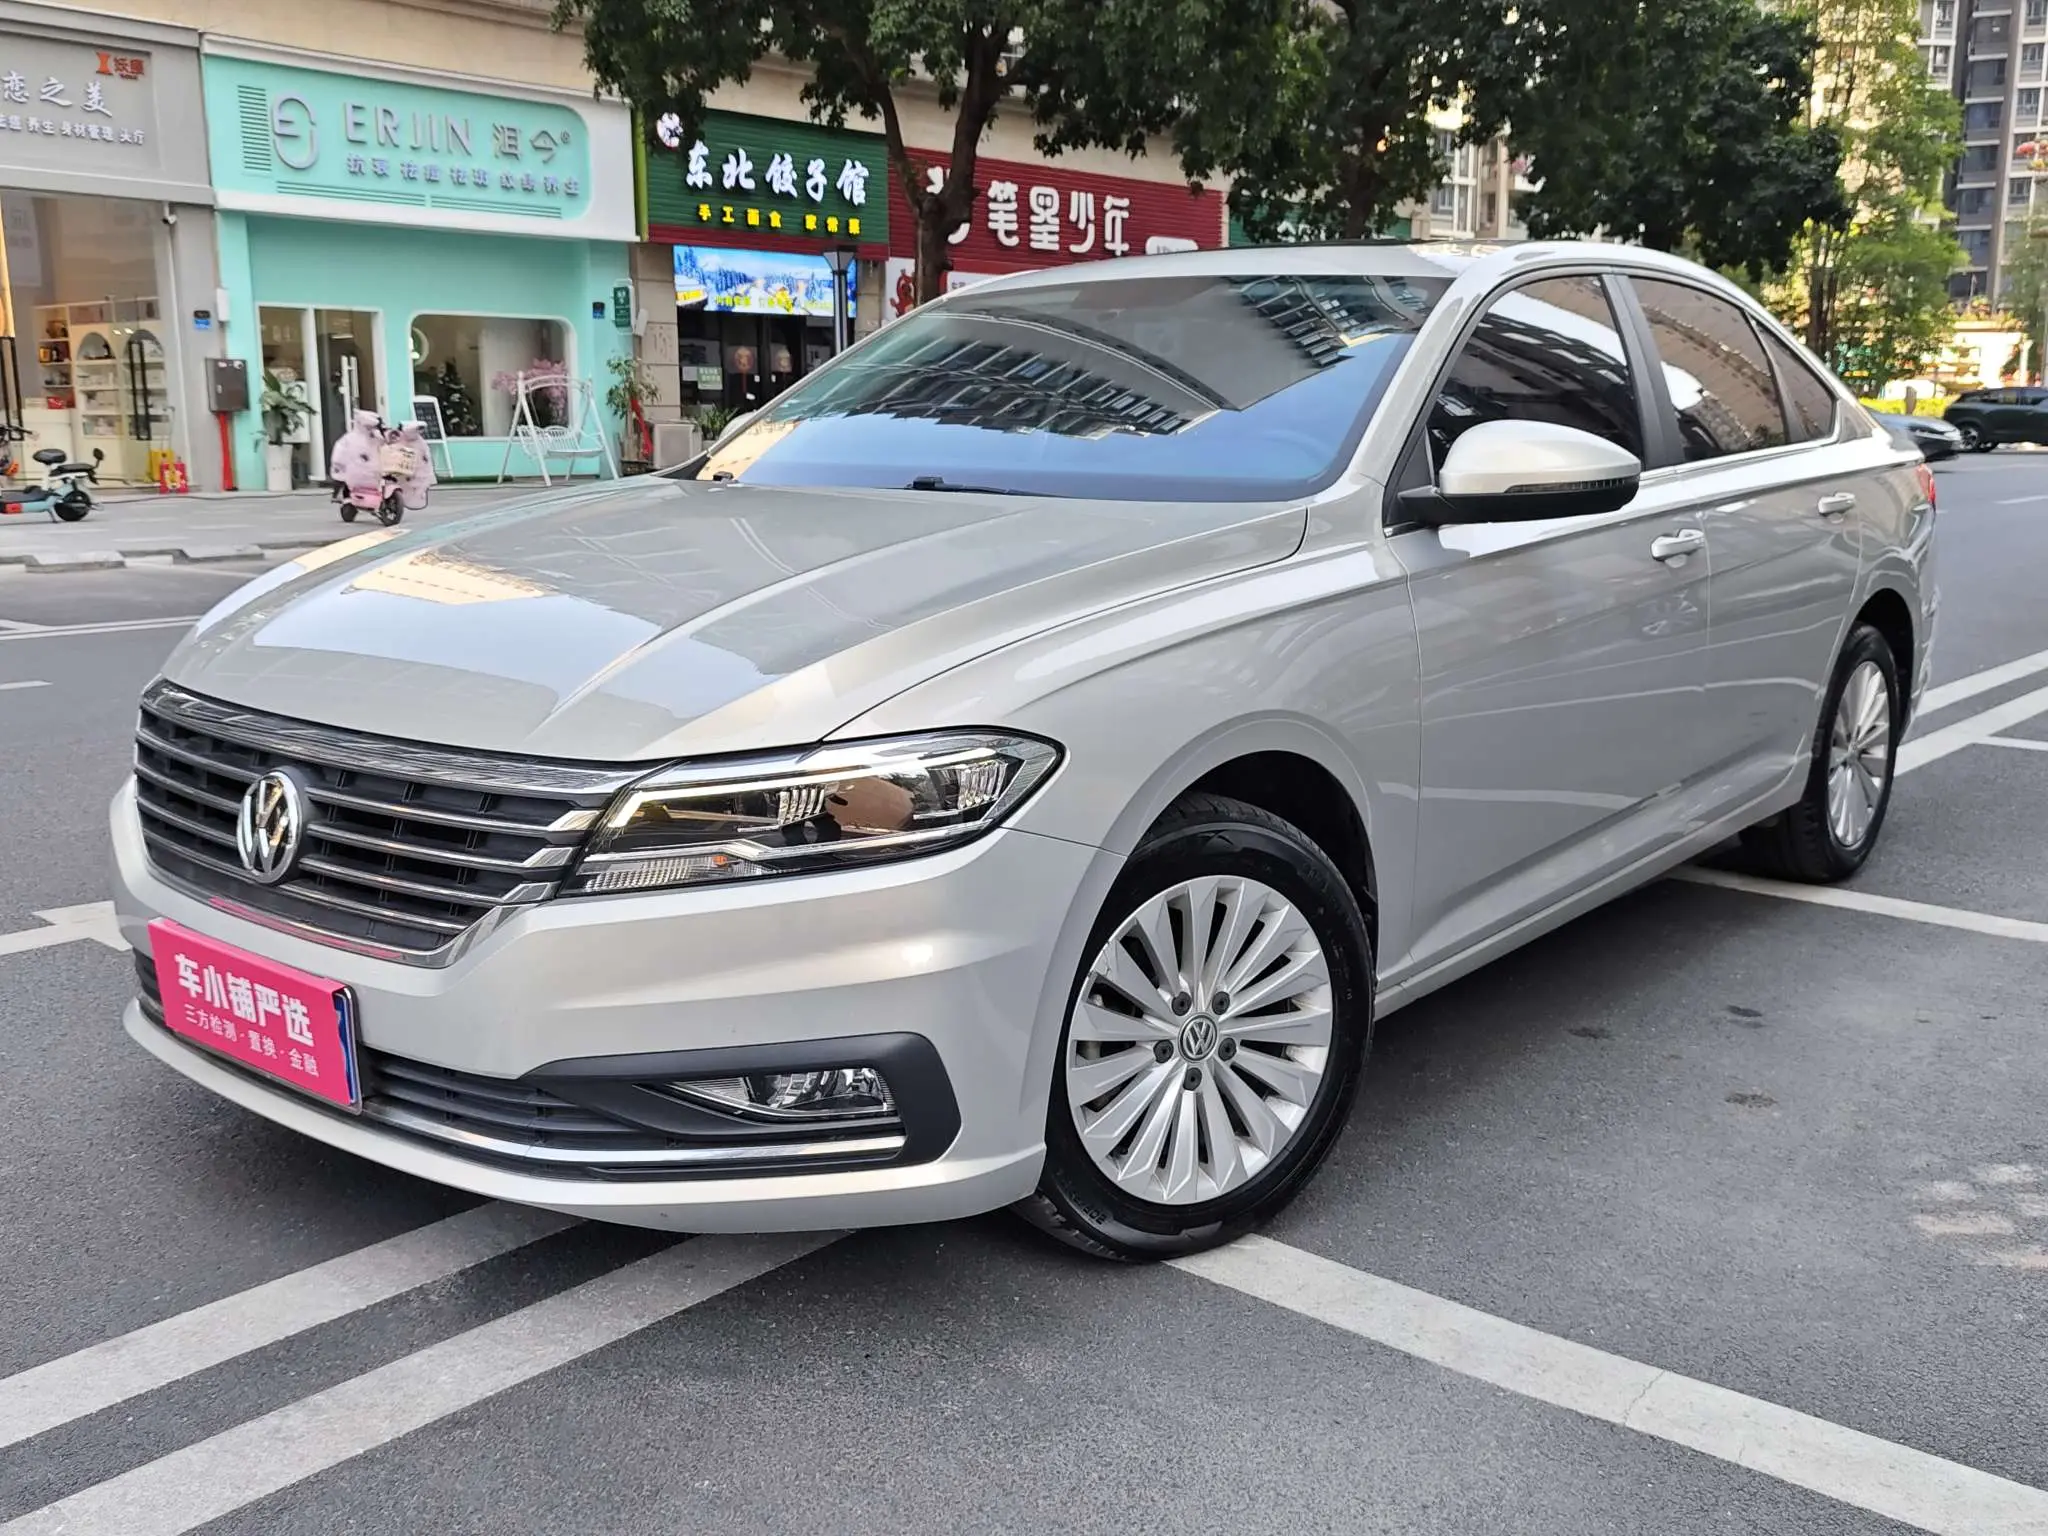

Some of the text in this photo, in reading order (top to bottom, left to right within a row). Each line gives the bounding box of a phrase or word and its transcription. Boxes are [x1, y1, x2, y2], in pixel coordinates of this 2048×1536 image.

[344, 101, 473, 157] ERJIN
[686, 139, 869, 206] 东北饺子馆
[698, 203, 782, 228] 手工面食
[174, 953, 314, 1047] 车小铺严选
